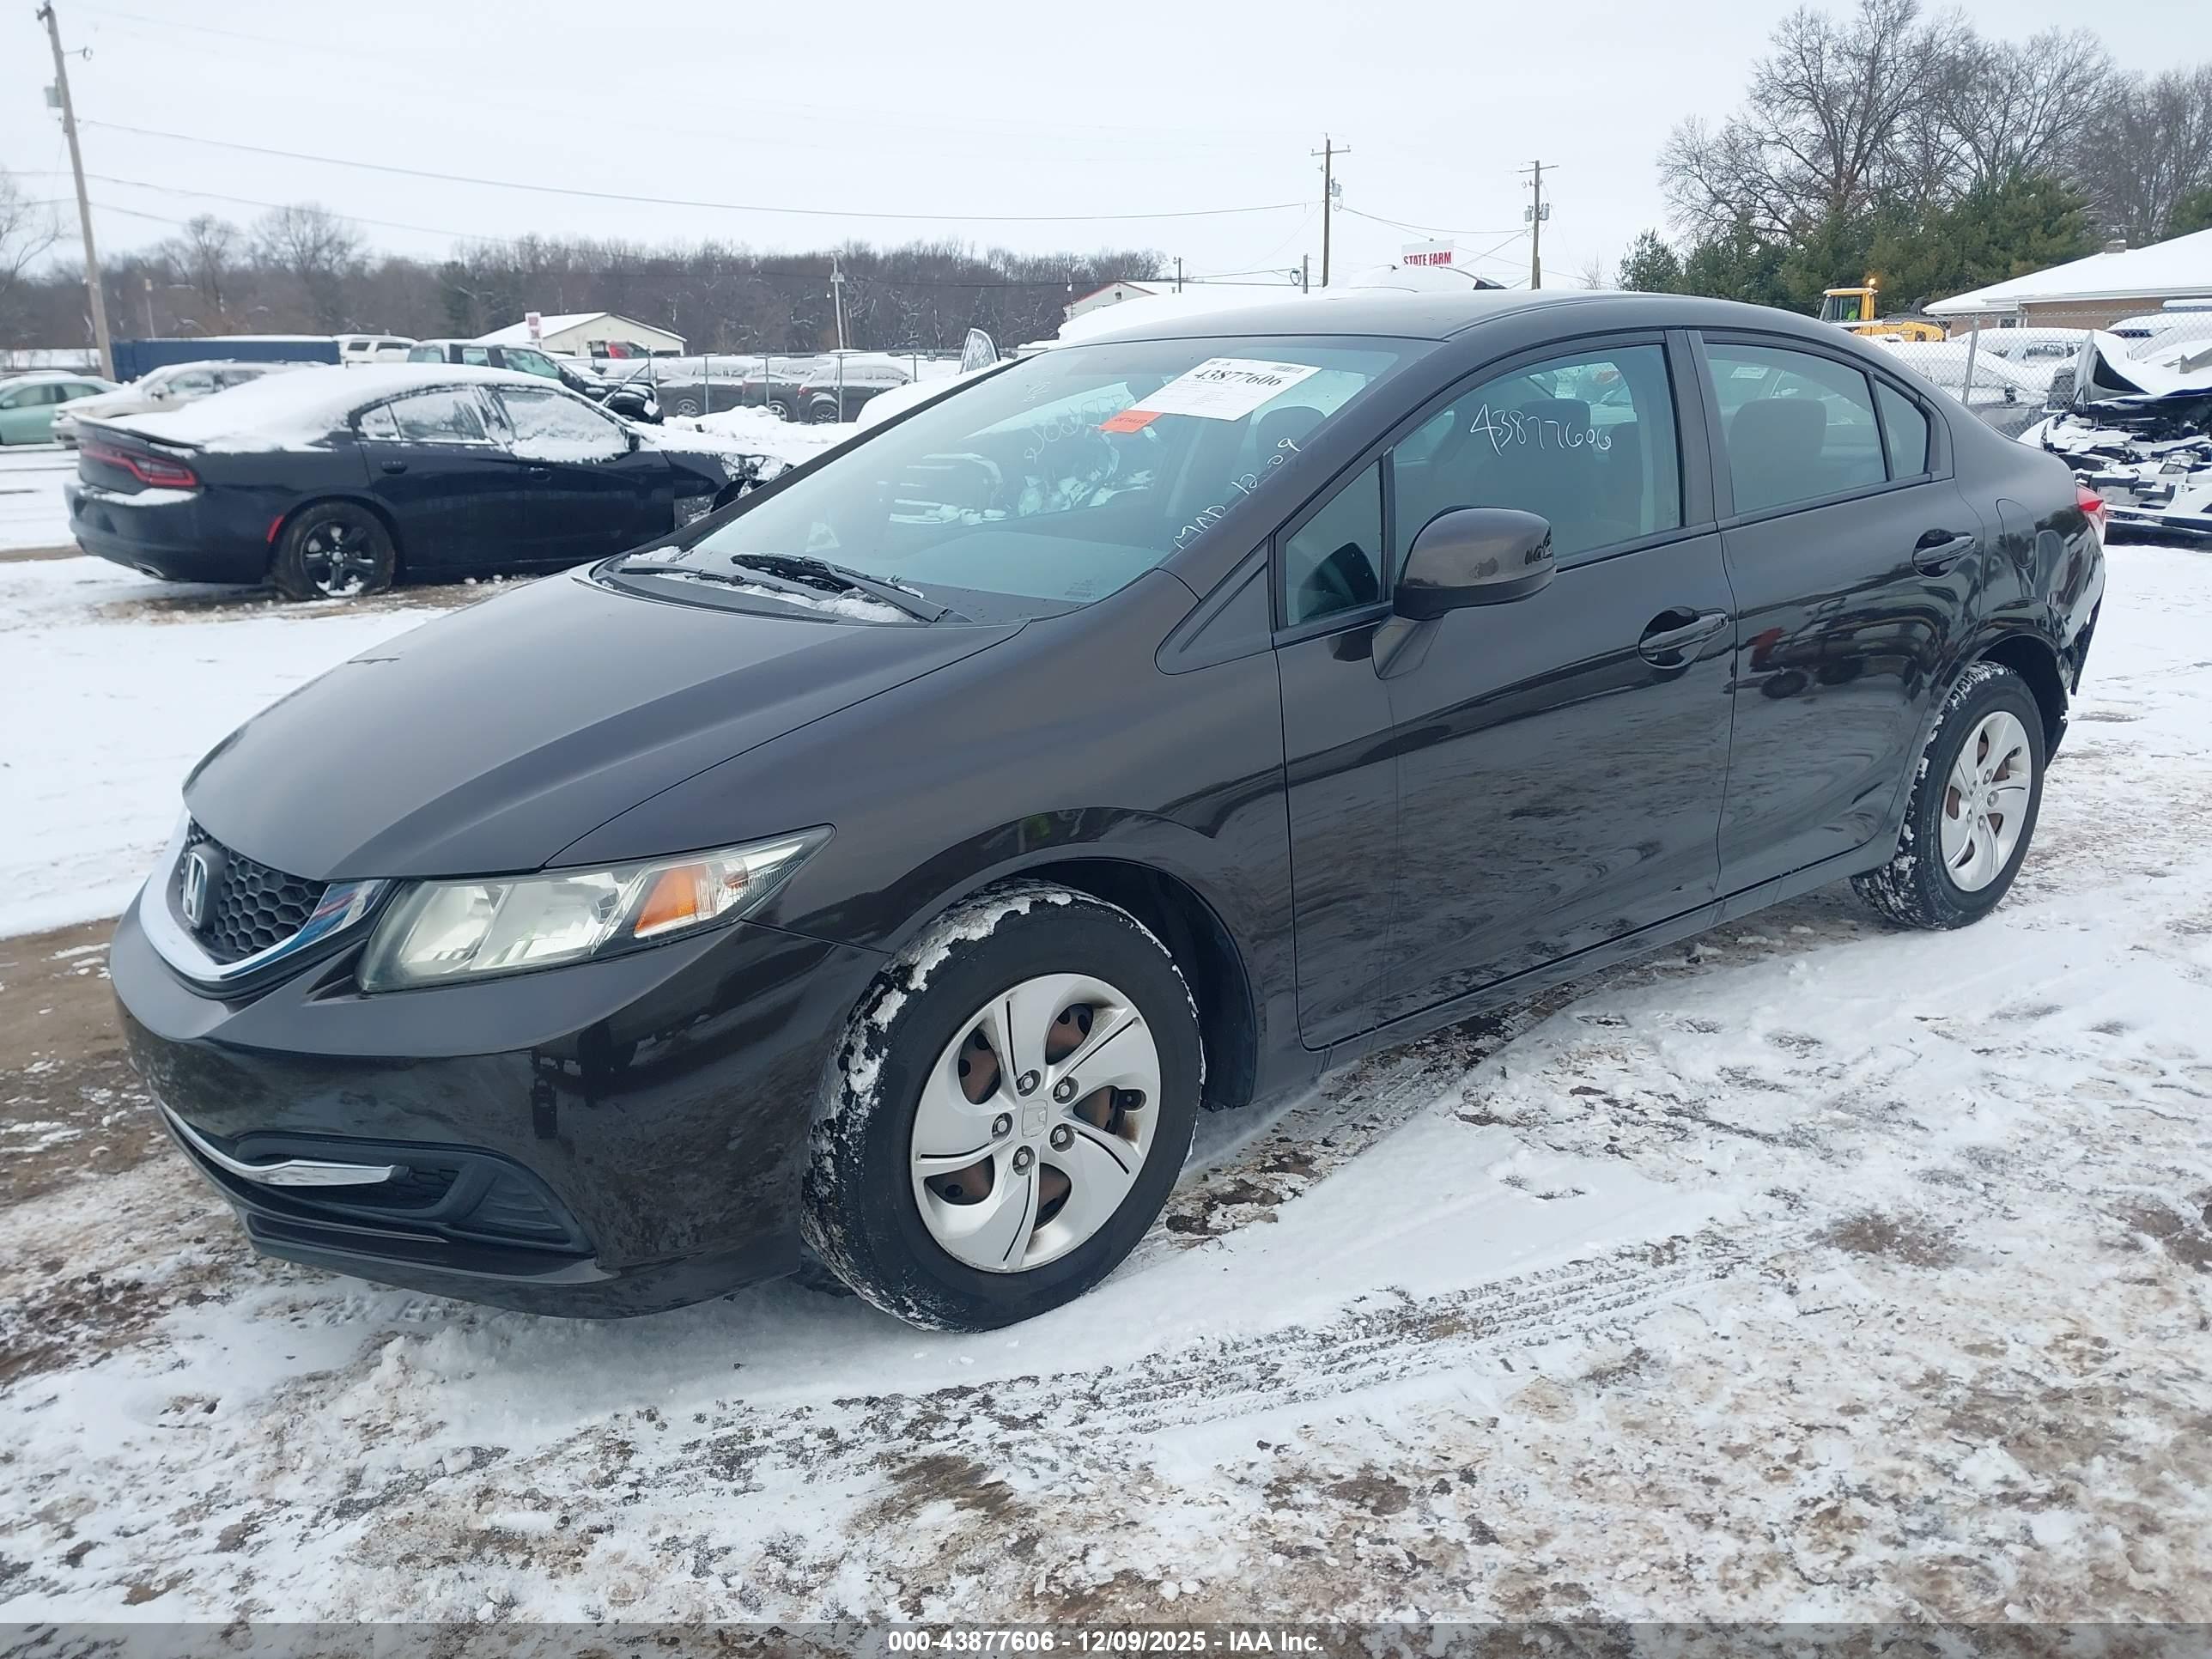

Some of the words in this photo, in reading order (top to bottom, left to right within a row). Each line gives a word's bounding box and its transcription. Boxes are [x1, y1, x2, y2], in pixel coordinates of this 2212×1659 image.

[1403, 253, 1426, 266] STATE
[1429, 252, 1451, 265] FARM
[1194, 369, 1289, 386] 43877606
[1469, 404, 1612, 457] 43877606
